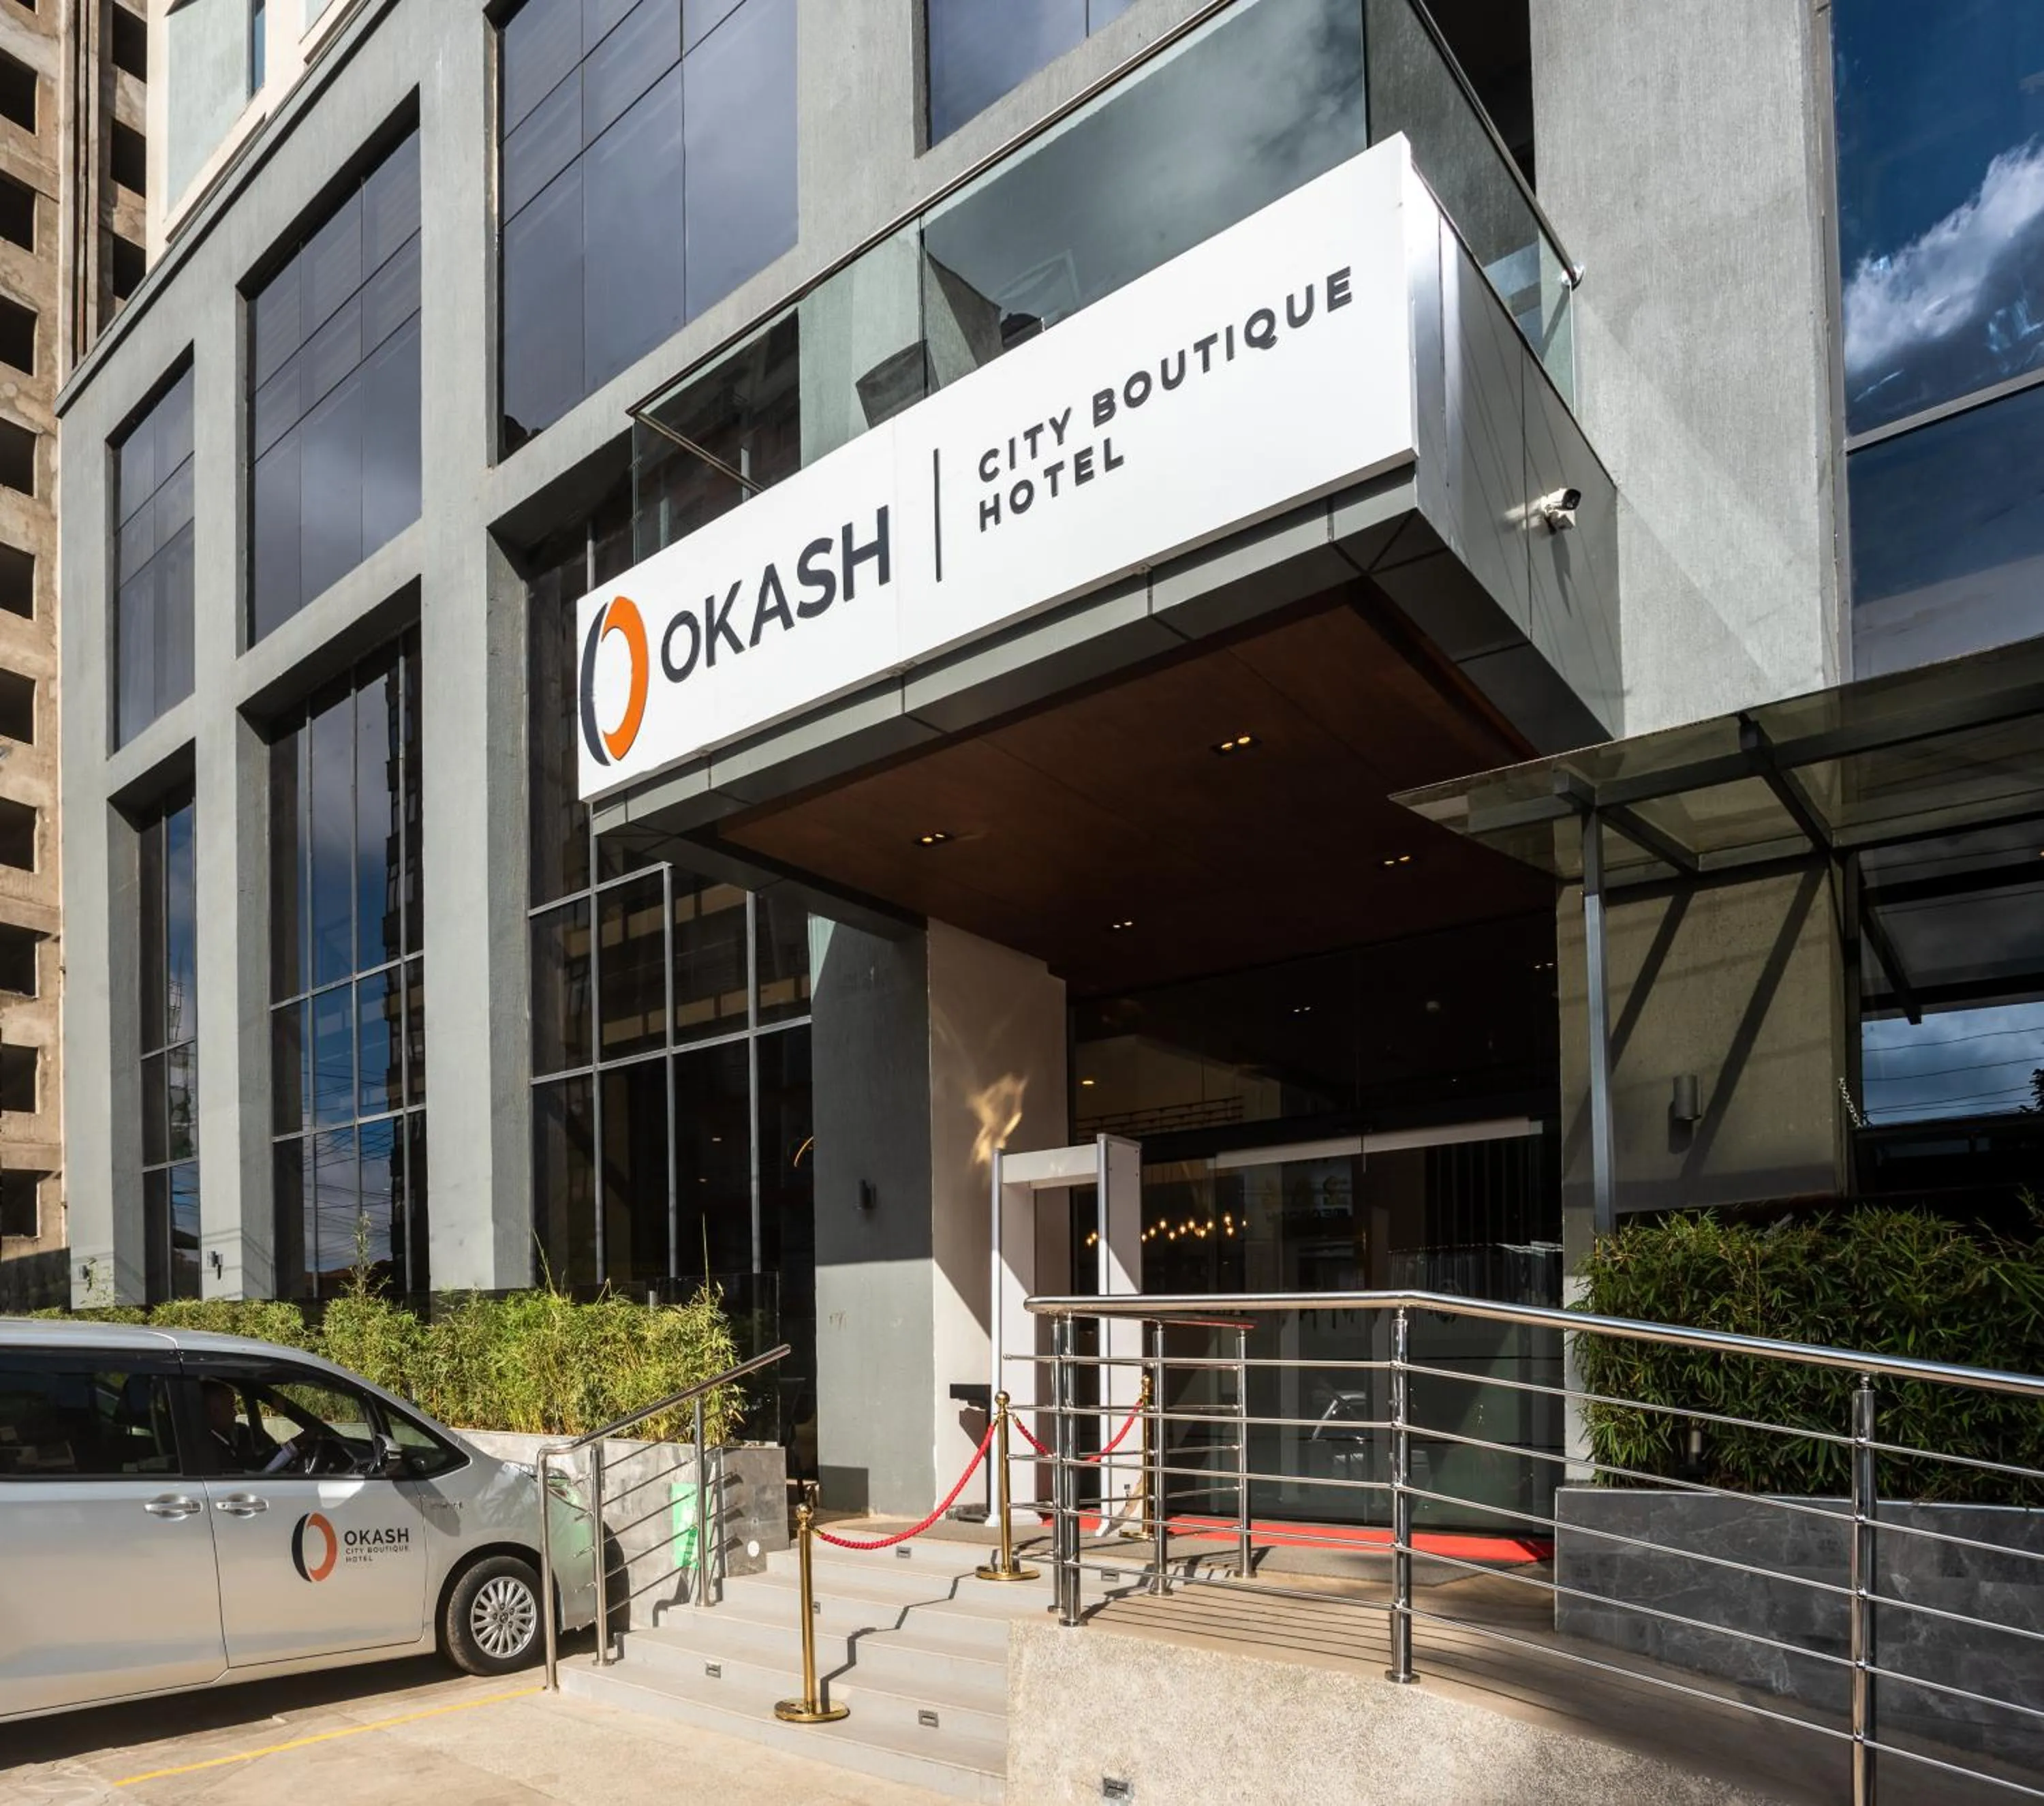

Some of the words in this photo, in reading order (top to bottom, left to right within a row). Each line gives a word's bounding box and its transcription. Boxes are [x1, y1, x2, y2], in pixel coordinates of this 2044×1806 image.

[978, 407, 1071, 483] CITY
[1092, 266, 1353, 428] BOUTIQUE
[979, 438, 1124, 532] HOTEL
[660, 505, 891, 684] OKASH
[344, 1528, 409, 1546] OKASH
[367, 1545, 409, 1554] BOUTIQUE
